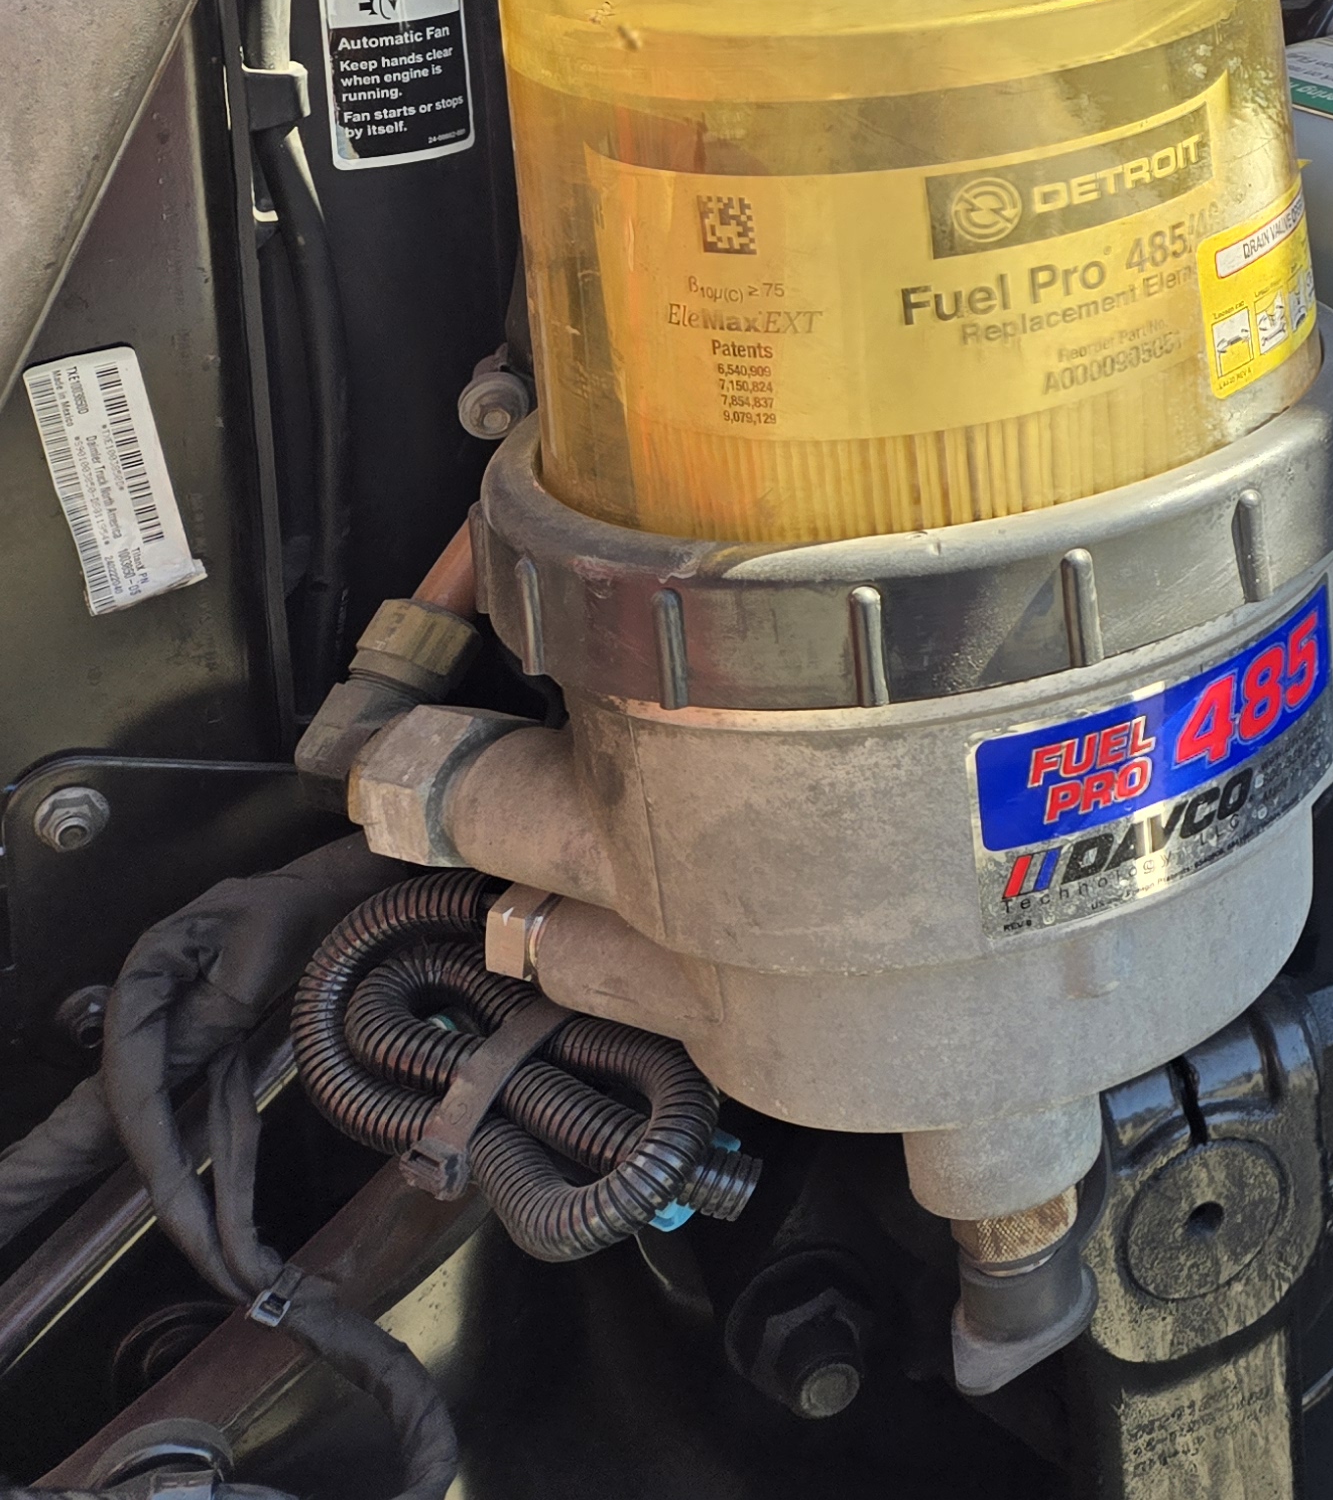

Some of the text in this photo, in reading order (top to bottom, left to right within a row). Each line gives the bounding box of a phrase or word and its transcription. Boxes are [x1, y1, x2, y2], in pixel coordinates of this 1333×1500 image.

[338, 25, 450, 51] Automatic Fan
[340, 46, 454, 72] Keep hands clear
[340, 63, 443, 87] when engine is
[342, 87, 402, 102] running.
[343, 95, 464, 123] Fan starts or stops
[345, 120, 408, 140] by itself.
[1033, 133, 1200, 214] DETROIT
[762, 282, 785, 298] 75
[900, 273, 1012, 327] Fuel
[961, 283, 1139, 346] Replacement
[1119, 325, 1147, 345] Part
[711, 338, 774, 359] Patents
[717, 362, 771, 378] 6,540,909
[52, 370, 75, 428] Made in Mexico
[719, 378, 773, 394] 7,150,824
[721, 394, 774, 409] 7,854,837
[723, 410, 777, 426] 9,079,129
[85, 434, 101, 463] Daimler
[93, 464, 106, 488] Truck
[100, 487, 112, 508] North
[106, 506, 123, 540] America
[130, 547, 149, 585] TitanX PN
[1027, 714, 1157, 788] FUEL
[1172, 611, 1319, 771] 485
[1044, 756, 1153, 825] PRO
[1061, 766, 1253, 885] DAYCO
